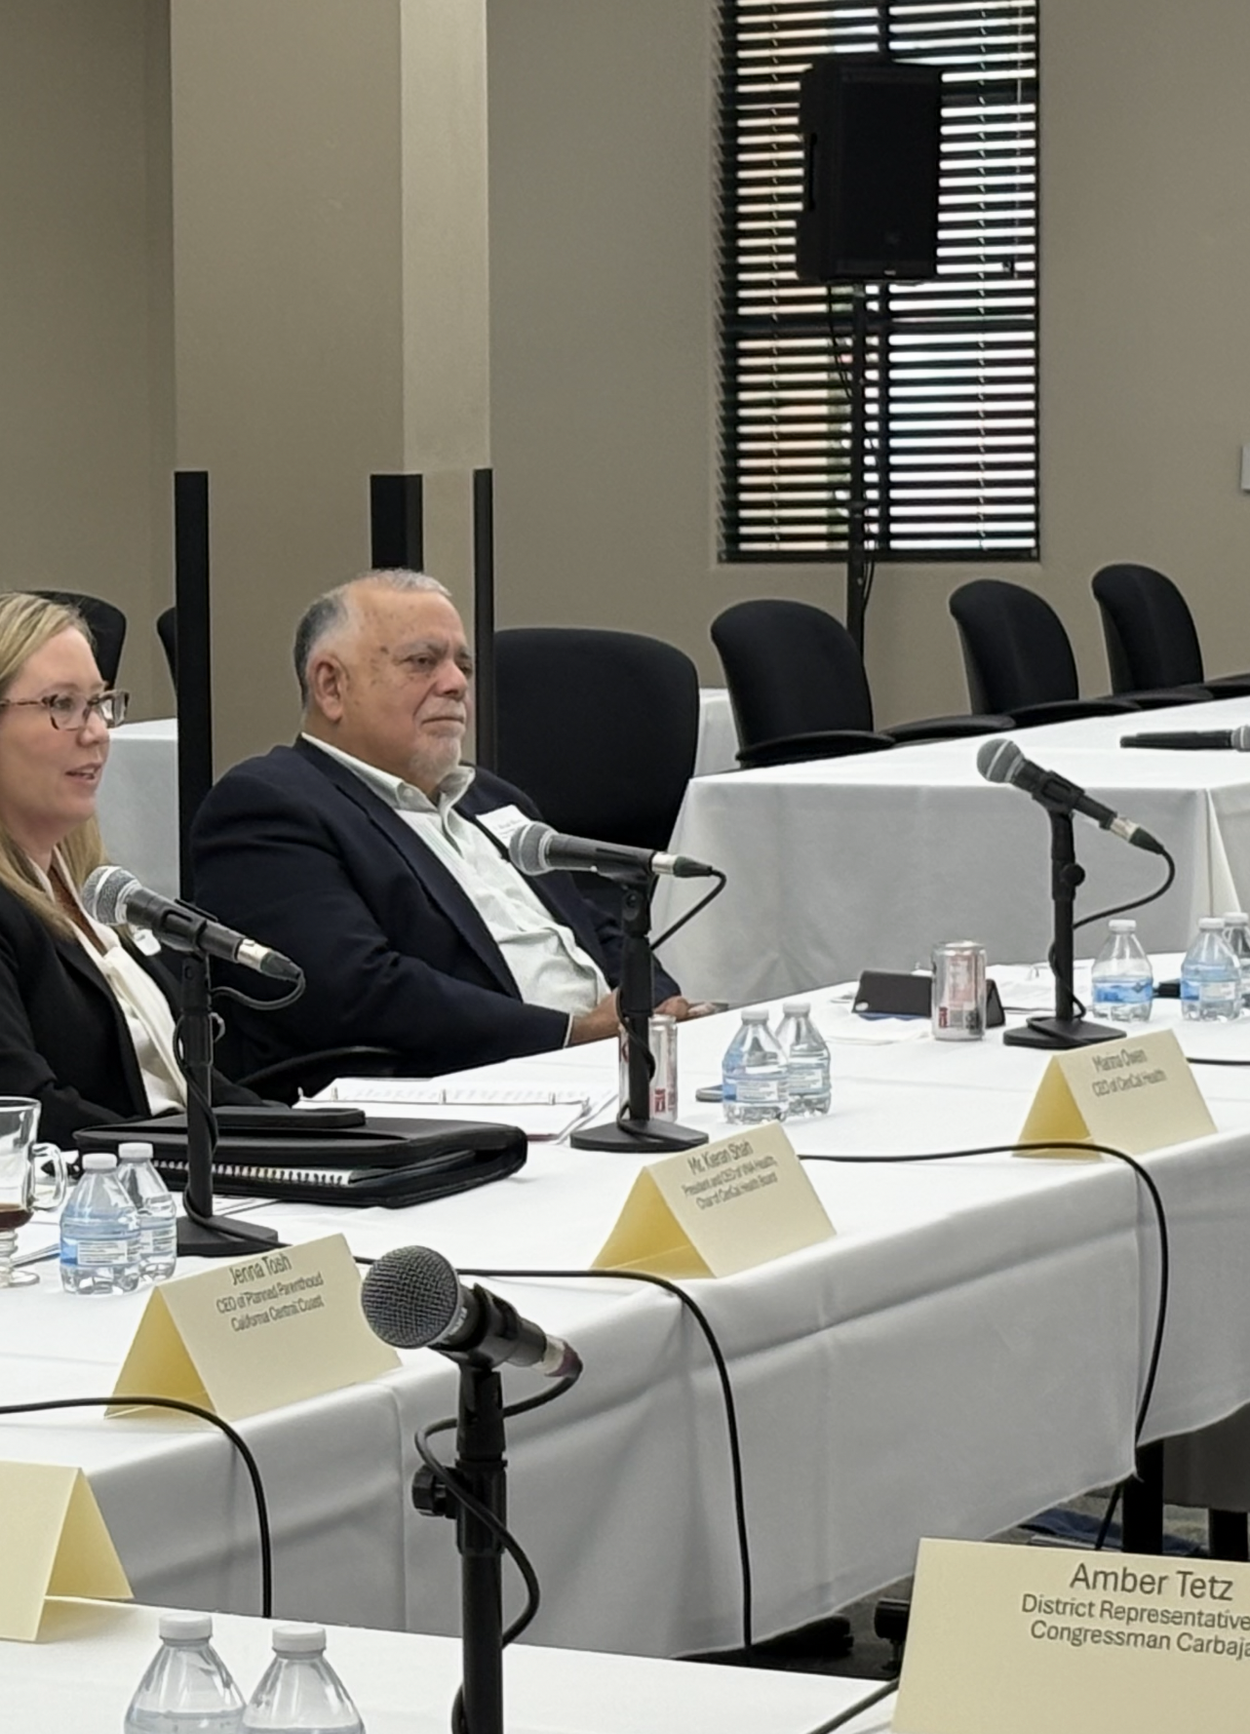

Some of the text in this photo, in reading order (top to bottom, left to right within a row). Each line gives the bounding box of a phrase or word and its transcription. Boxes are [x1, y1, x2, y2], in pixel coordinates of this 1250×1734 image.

[229, 1252, 292, 1286] Jenna Tosh
[216, 1296, 237, 1314] CEO
[244, 1285, 278, 1306] Planned
[277, 1271, 324, 1296] Parenthood
[231, 1295, 325, 1332] California Central Coast
[1069, 1562, 1234, 1602] Amber Tetz
[1021, 1594, 1250, 1631] District Representative
[1030, 1620, 1171, 1650] Congressman
